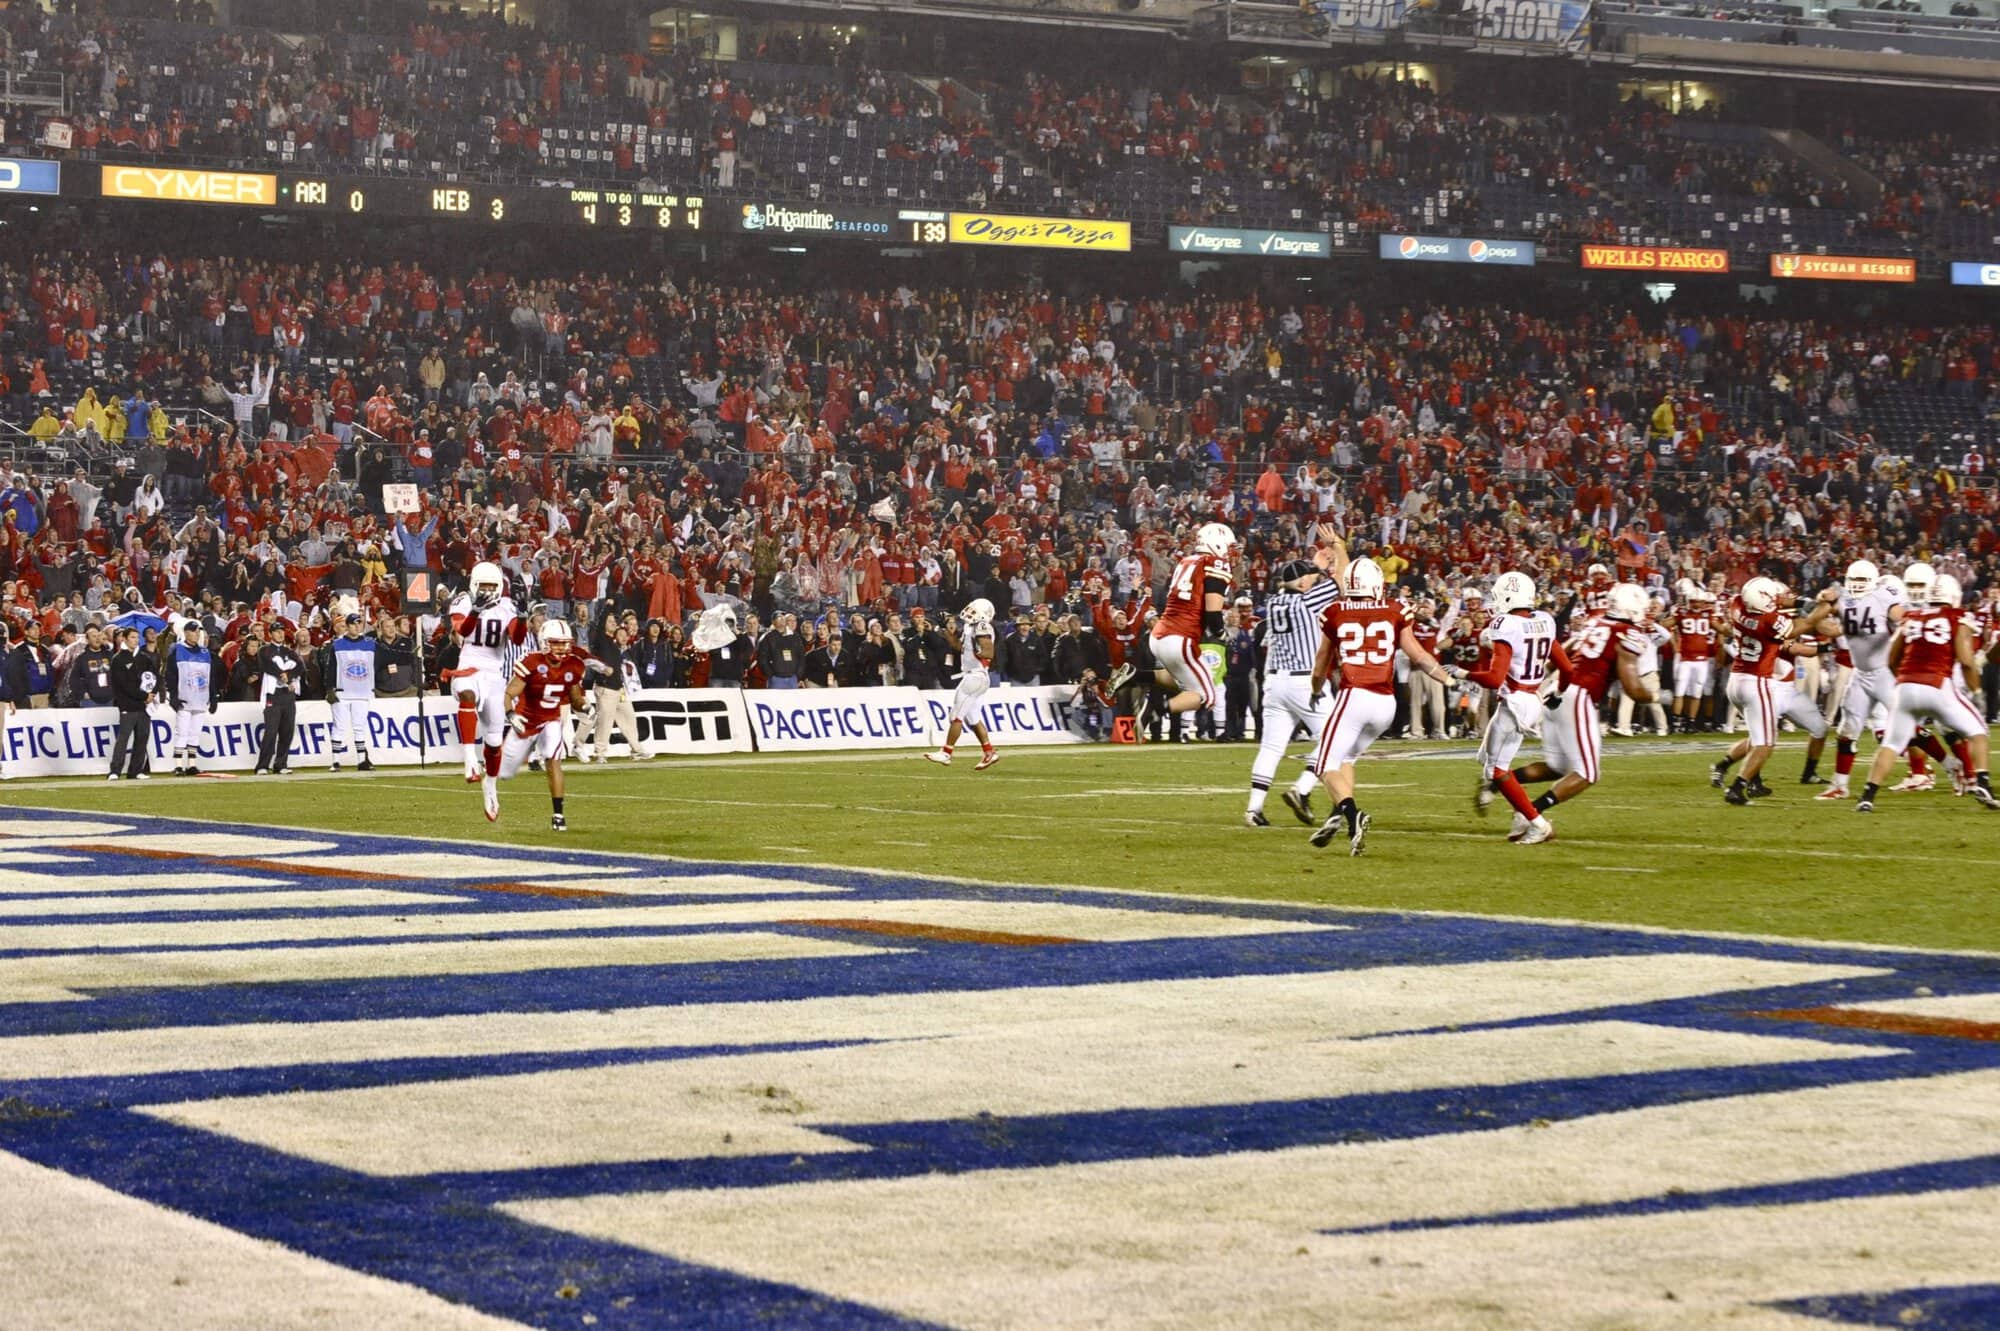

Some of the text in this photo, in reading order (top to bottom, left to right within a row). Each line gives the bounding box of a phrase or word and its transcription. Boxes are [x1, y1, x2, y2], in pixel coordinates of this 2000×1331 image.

[115, 168, 263, 201] CYMER
[295, 181, 327, 204] ARI
[350, 191, 363, 212] 0
[432, 189, 470, 212] NEB
[491, 199, 504, 219] 3
[571, 190, 598, 202] DOWN
[605, 193, 617, 204] TO
[619, 193, 632, 204] GO
[642, 194, 664, 206] BALL
[584, 204, 596, 224] 4
[619, 205, 632, 226] 3
[659, 207, 671, 228] 8
[688, 209, 700, 230] 4
[765, 203, 889, 233] Brigantine SEAFOOD
[964, 217, 1117, 244] Oggi's Pizza
[1195, 233, 1242, 250] Degree
[1273, 237, 1320, 254] Degree
[1420, 243, 1449, 255] pepsi
[1585, 248, 1726, 269] WELLS FARGO
[1861, 263, 1912, 276] RESORT
[407, 573, 430, 602] 4
[471, 617, 502, 648] 18
[1682, 617, 1709, 636] 90
[1844, 606, 1877, 637] 64
[1336, 621, 1395, 665] 23
[1520, 637, 1551, 680] 19
[540, 683, 564, 709] 5
[755, 703, 924, 739] PACIFIC LIFE
[61, 721, 120, 759] LIF
